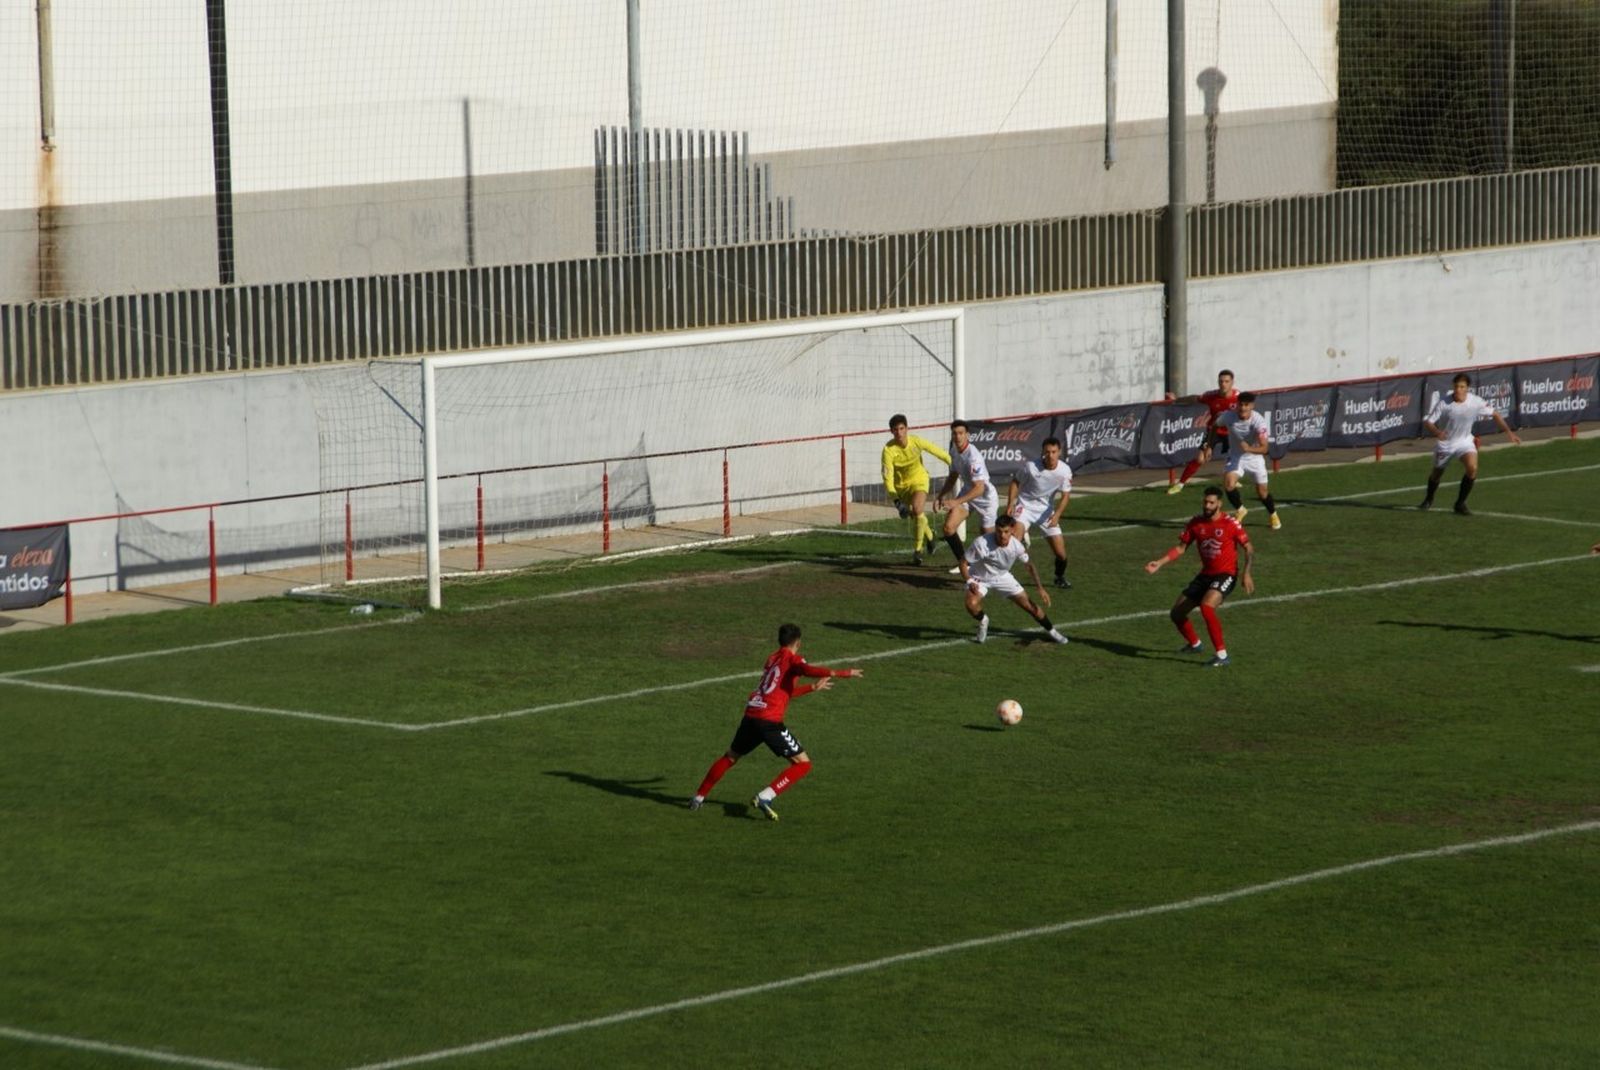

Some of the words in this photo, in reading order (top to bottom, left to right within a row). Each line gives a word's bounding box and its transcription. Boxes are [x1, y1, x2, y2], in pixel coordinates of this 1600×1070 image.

[1523, 377, 1564, 394] Huelva
[1345, 397, 1386, 415] Huelva
[1520, 401, 1539, 414] tus
[1275, 423, 1289, 435] DE
[1342, 421, 1363, 434] tus
